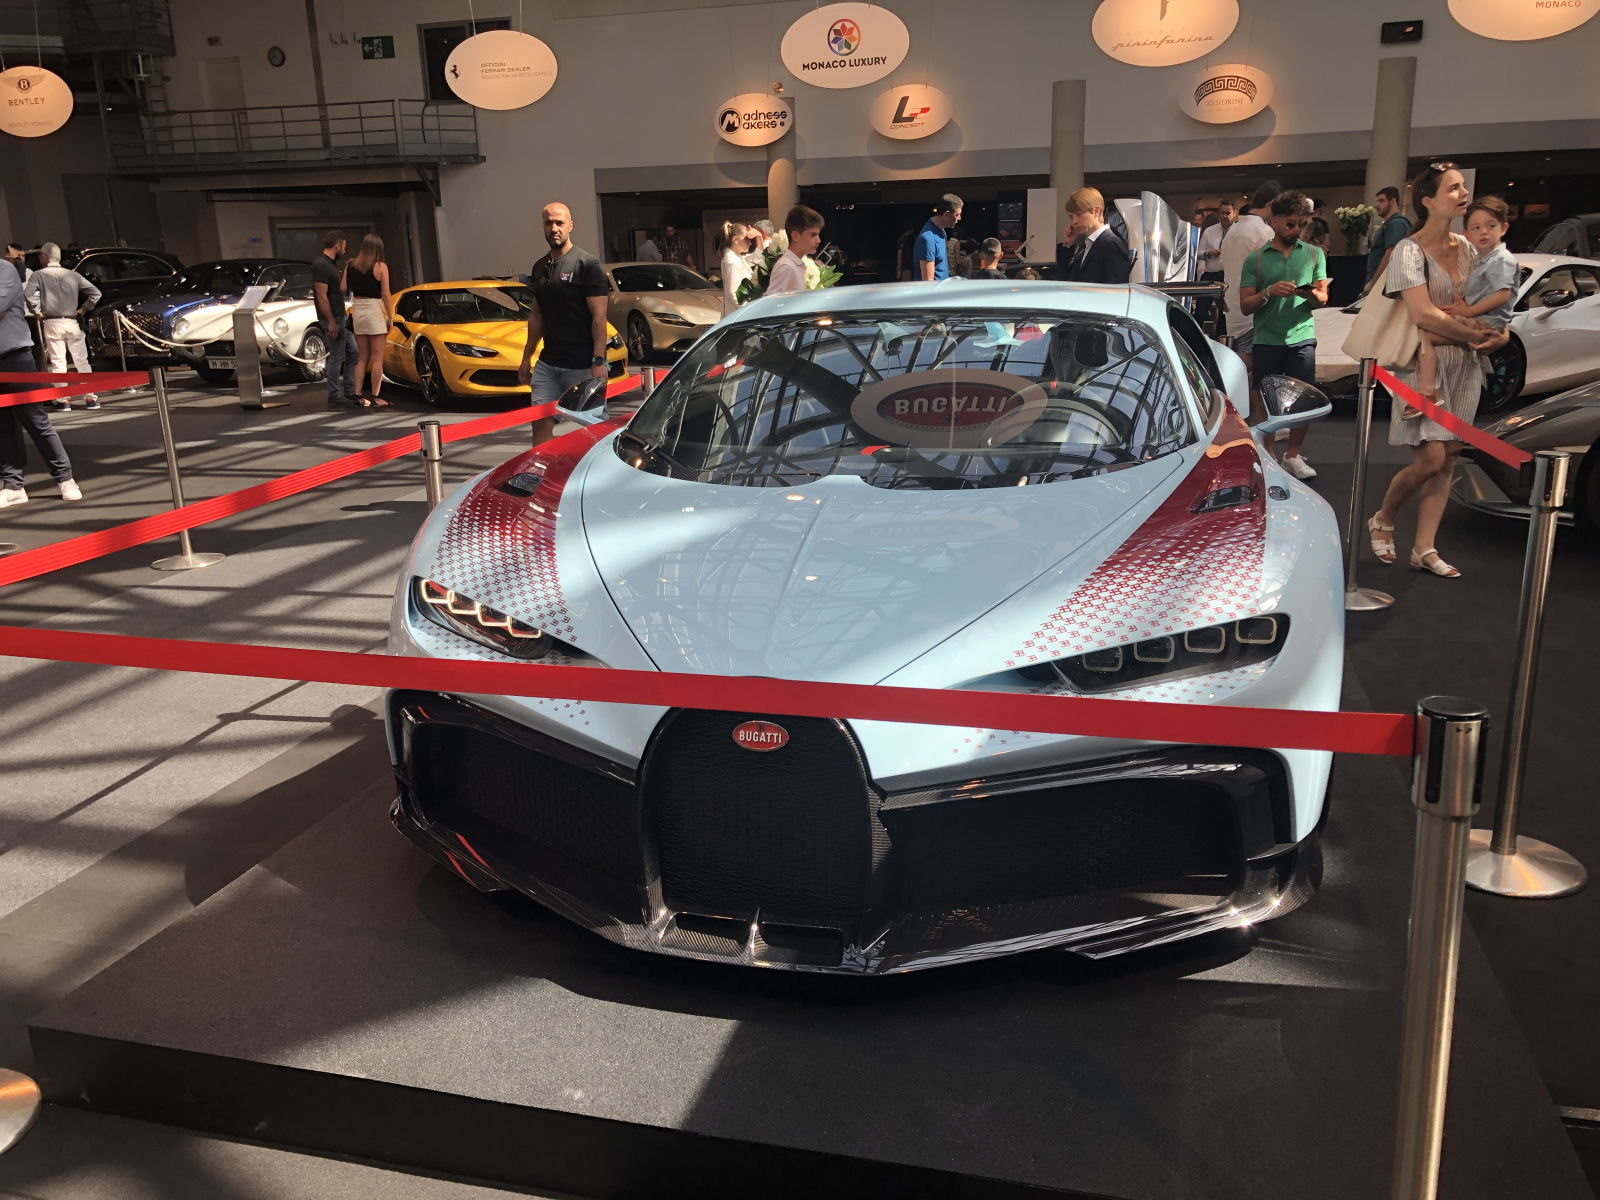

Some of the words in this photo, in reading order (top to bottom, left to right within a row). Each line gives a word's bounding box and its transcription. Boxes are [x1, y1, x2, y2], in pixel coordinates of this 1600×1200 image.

[1535, 0, 1581, 9] MONACO
[1112, 35, 1215, 51] pininfarina
[802, 60, 847, 71] MONACO
[849, 56, 887, 67] LUXURY
[8, 97, 45, 106] BENTLEY
[1206, 98, 1243, 107] ZENDRINI
[739, 730, 782, 744] BUGATTI
